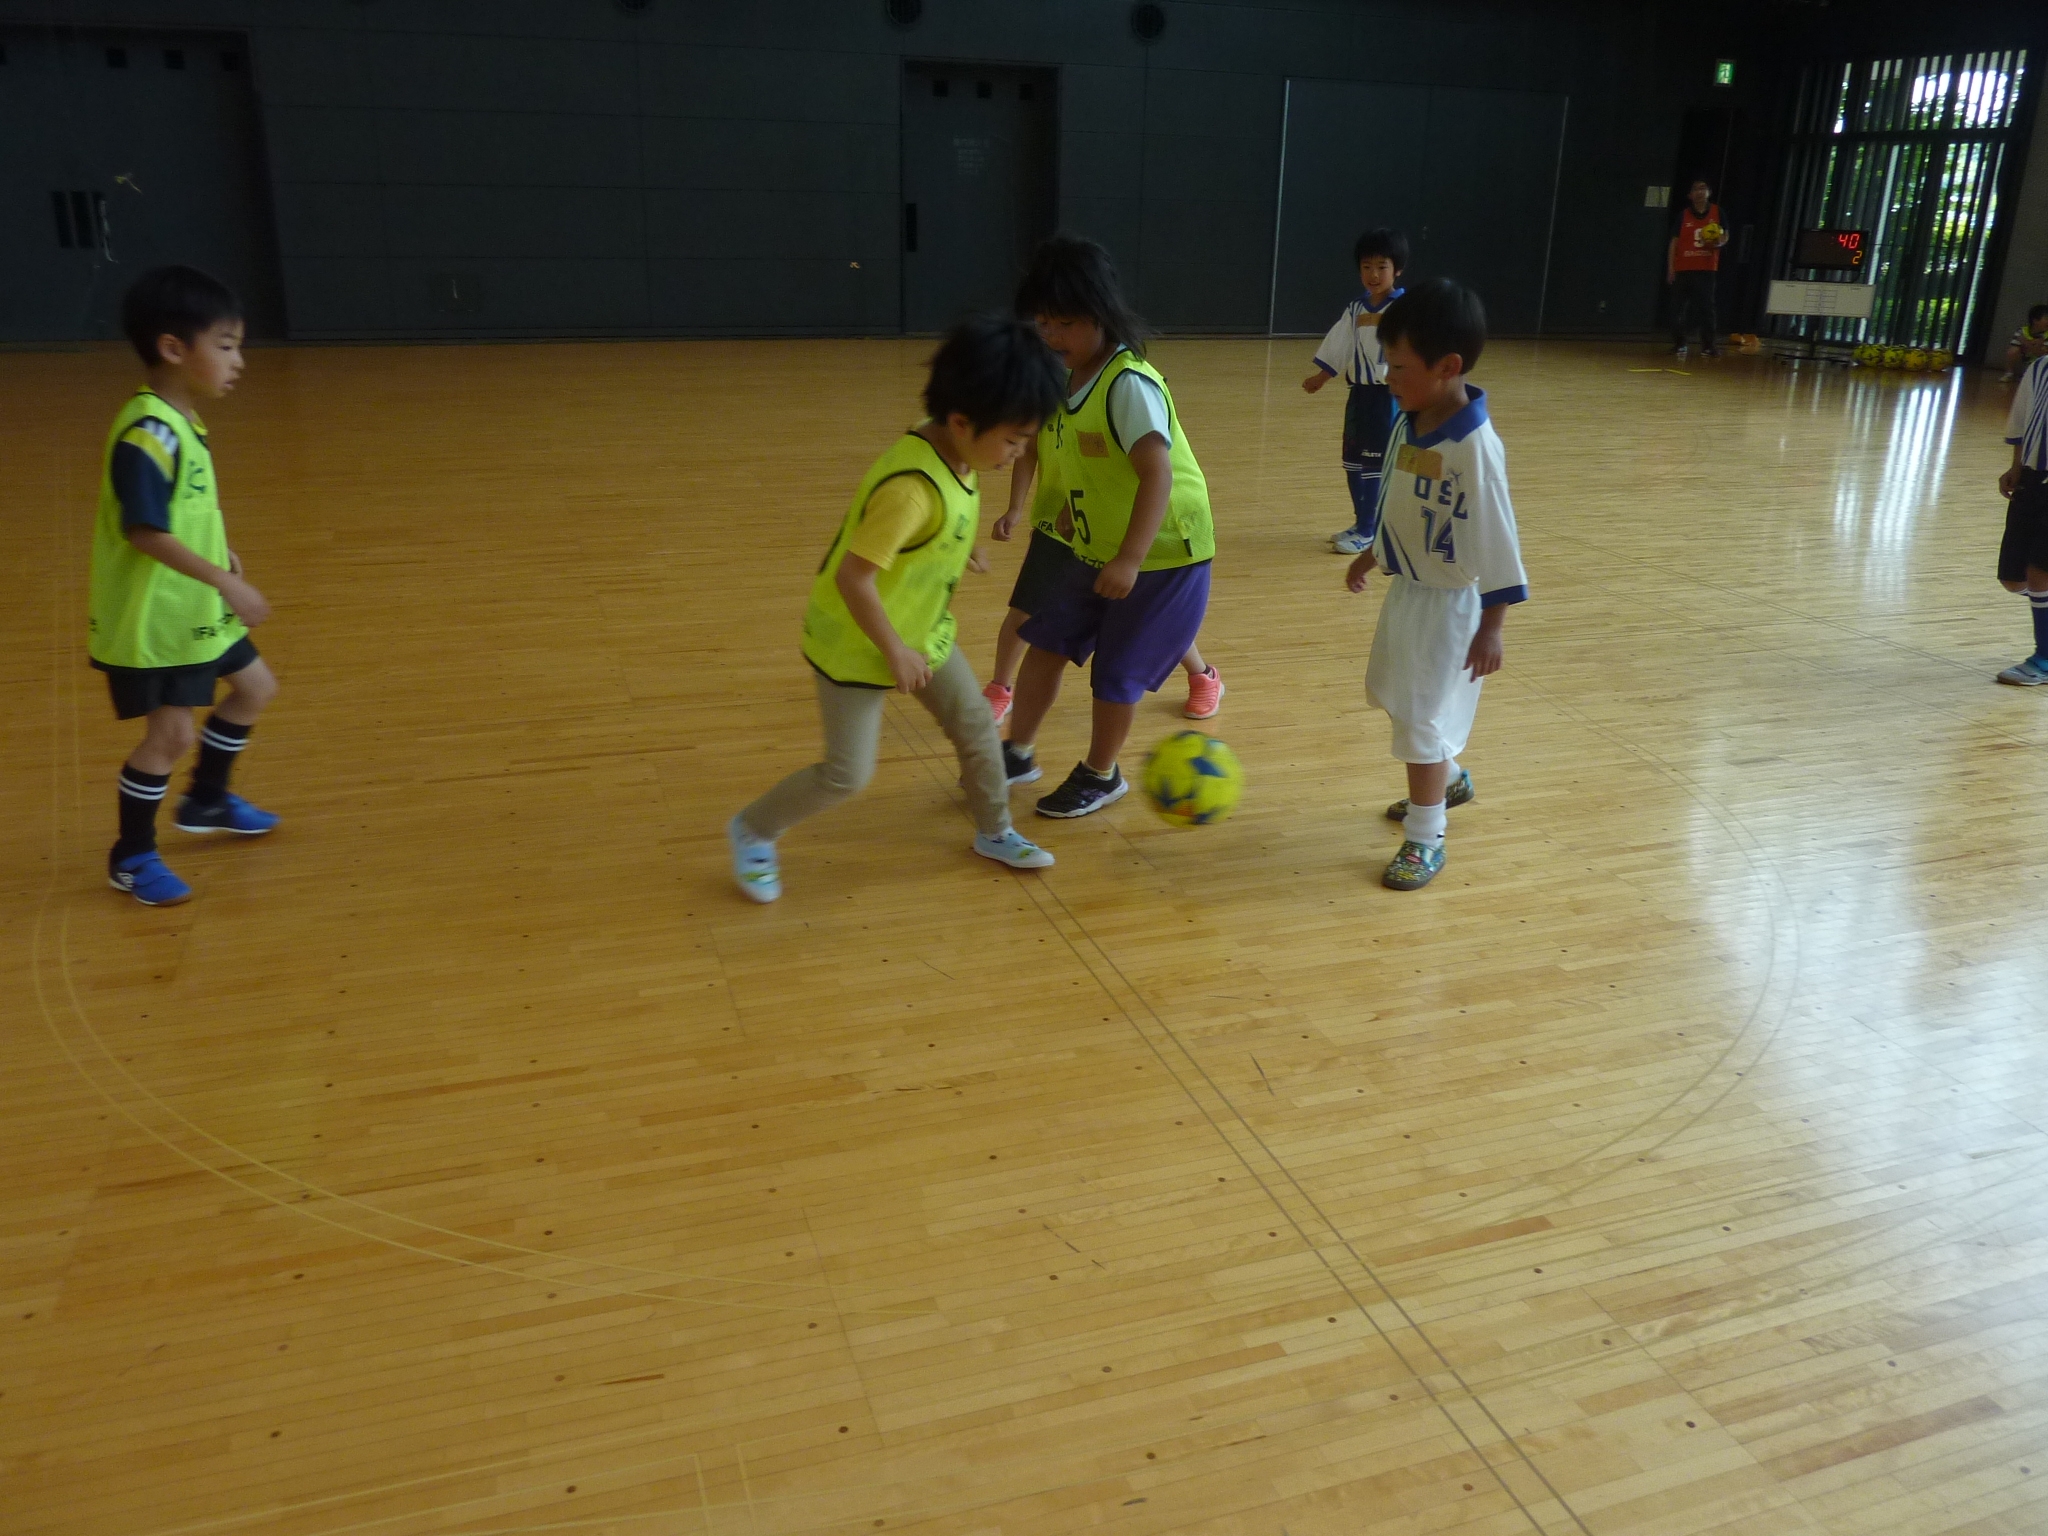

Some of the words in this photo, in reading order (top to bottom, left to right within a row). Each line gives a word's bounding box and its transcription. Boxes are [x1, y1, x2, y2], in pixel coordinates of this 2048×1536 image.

[1838, 233, 1860, 250] 40
[1852, 250, 1863, 265] 2
[1070, 489, 1091, 545] 5
[1420, 505, 1457, 564] 14
